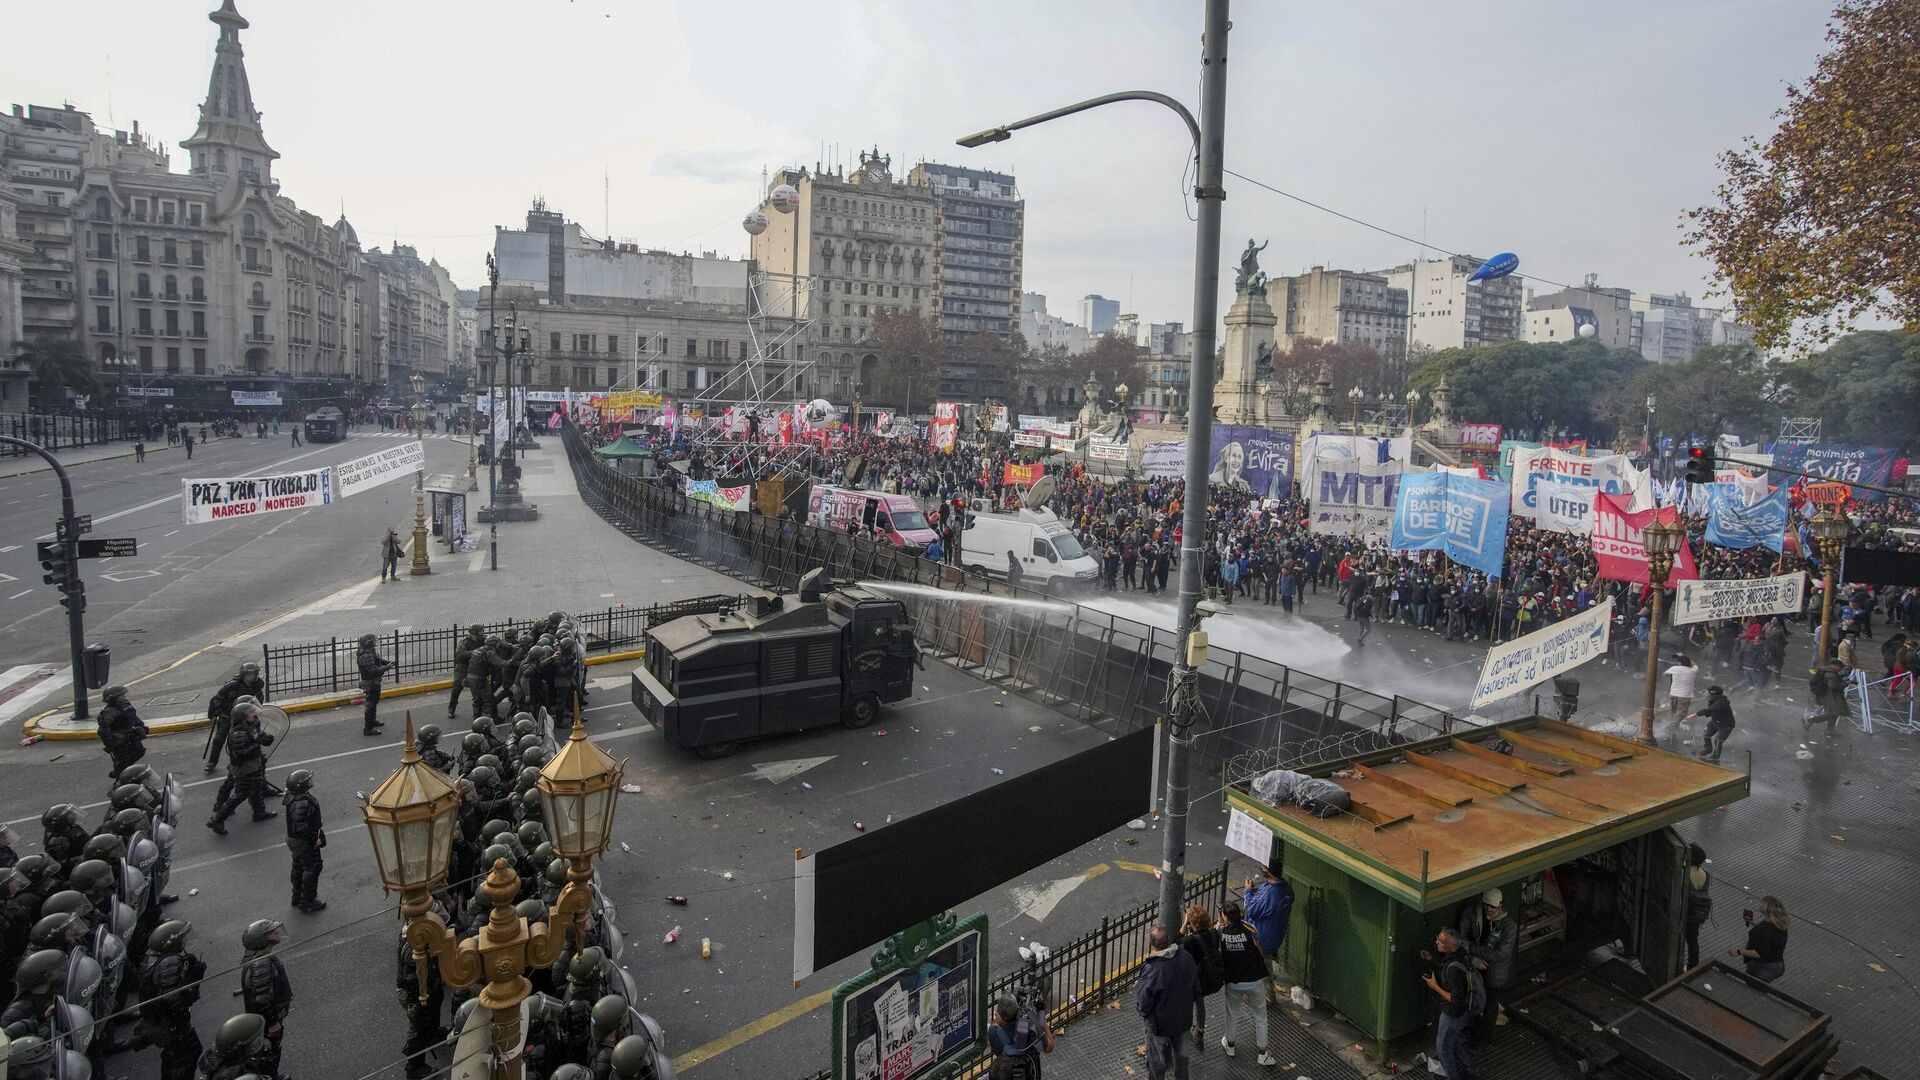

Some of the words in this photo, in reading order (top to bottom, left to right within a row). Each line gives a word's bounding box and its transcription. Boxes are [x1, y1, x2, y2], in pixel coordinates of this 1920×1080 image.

[339, 464, 354, 476] ESTOS
[382, 448, 404, 460] NUESTRA
[1246, 448, 1289, 477] Evita
[1806, 448, 1865, 459] movimiento
[342, 473, 362, 487] PAGAN
[362, 469, 373, 480] LOS
[372, 463, 390, 475] VIAJES
[390, 460, 401, 469] DEL
[1529, 457, 1592, 476] FRENTE
[1802, 459, 1862, 482] Evita
[260, 473, 318, 497] TRABAJO
[1715, 474, 1736, 483] NTE
[212, 502, 256, 518] MARCELO
[265, 495, 306, 511] MONTERO
[890, 503, 916, 511] PRENSA
[1549, 496, 1589, 520] UTEP
[1409, 512, 1438, 529] DE
[1610, 543, 1648, 558] POPU
[1221, 932, 1248, 943] PRENSA
[879, 989, 898, 1008] MISMO
[885, 1030, 914, 1055] TRAB
[887, 1045, 913, 1068] MARC
